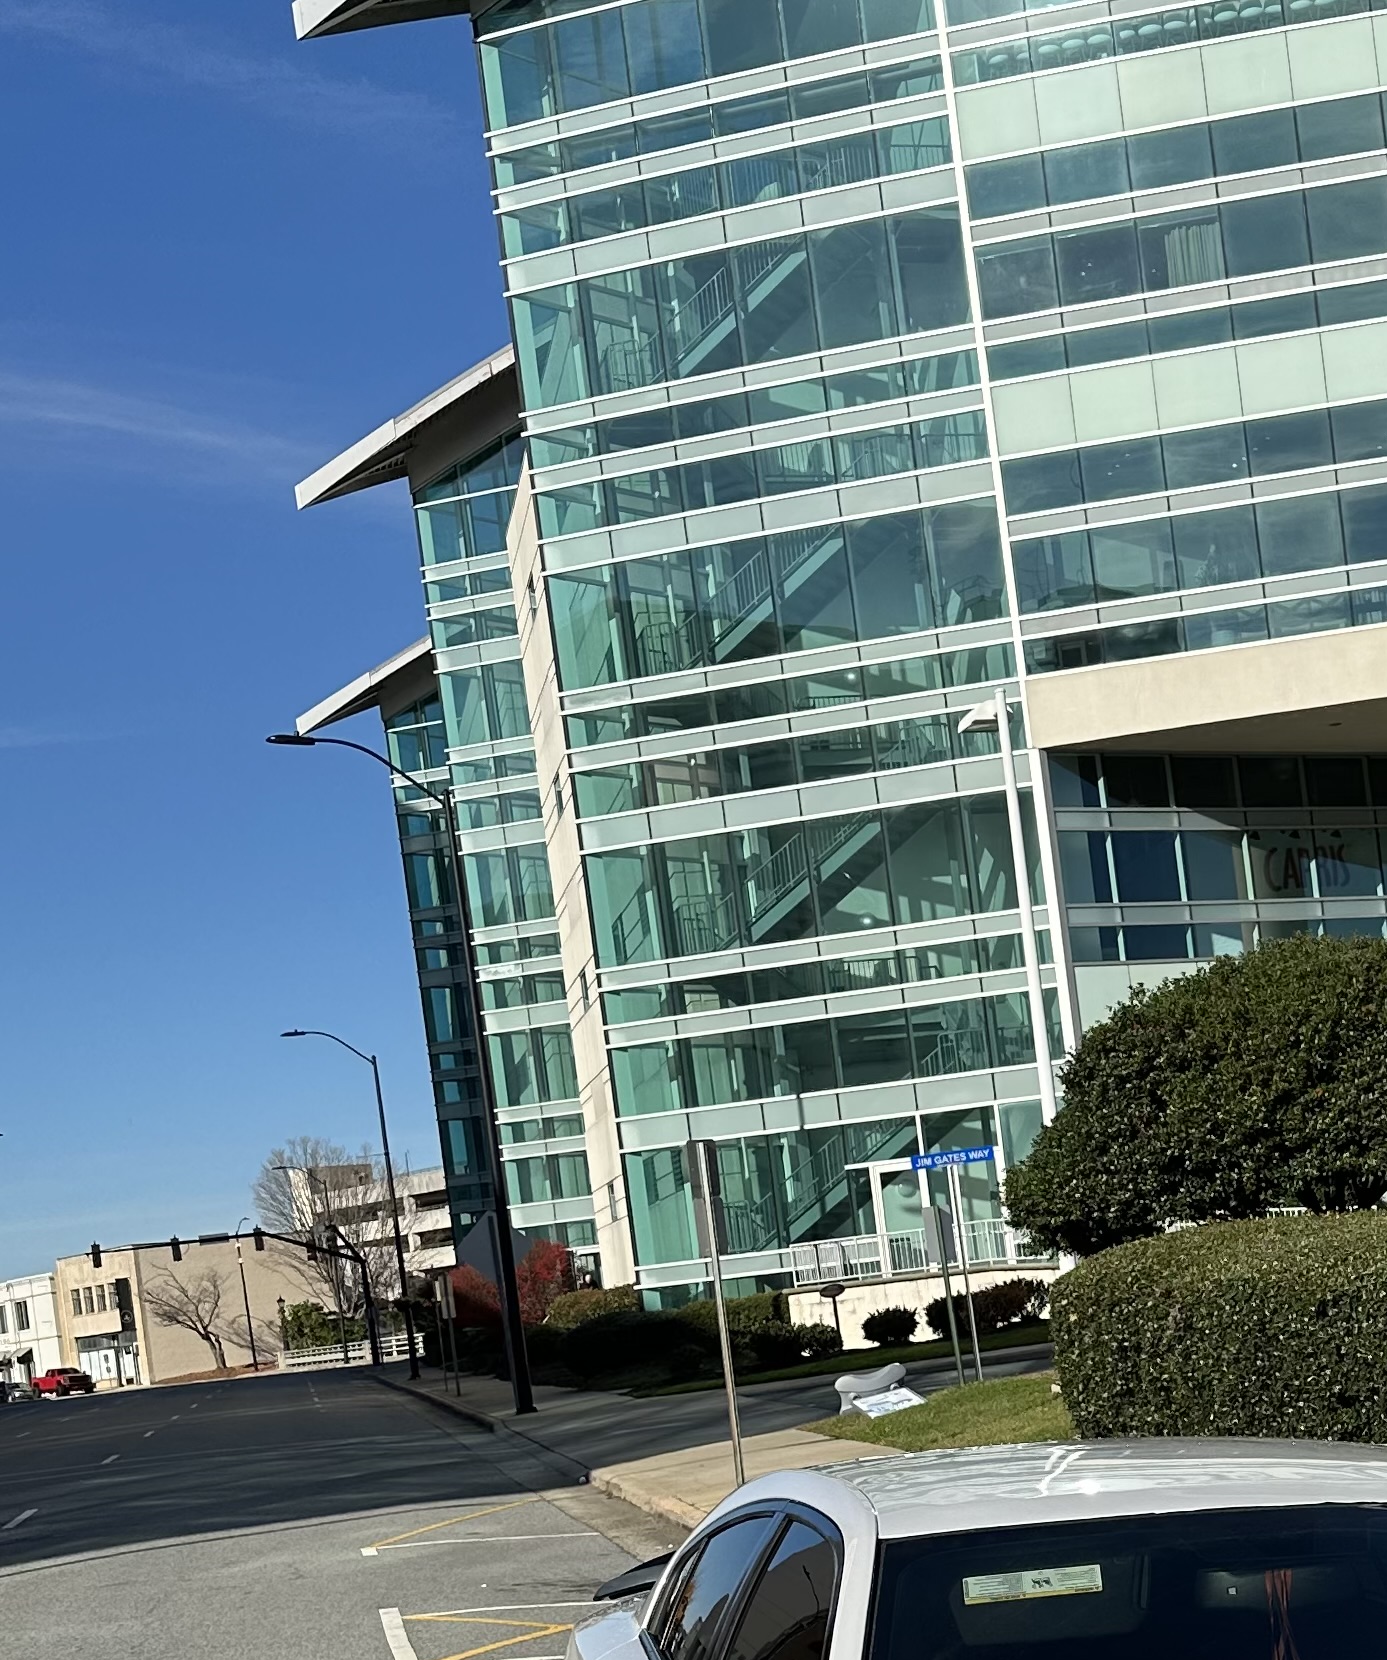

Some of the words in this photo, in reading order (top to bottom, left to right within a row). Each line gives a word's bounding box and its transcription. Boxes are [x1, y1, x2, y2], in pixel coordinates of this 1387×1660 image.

[916, 1157, 933, 1168] JIM
[934, 1152, 967, 1165] GATES
[968, 1149, 990, 1160] WAY
